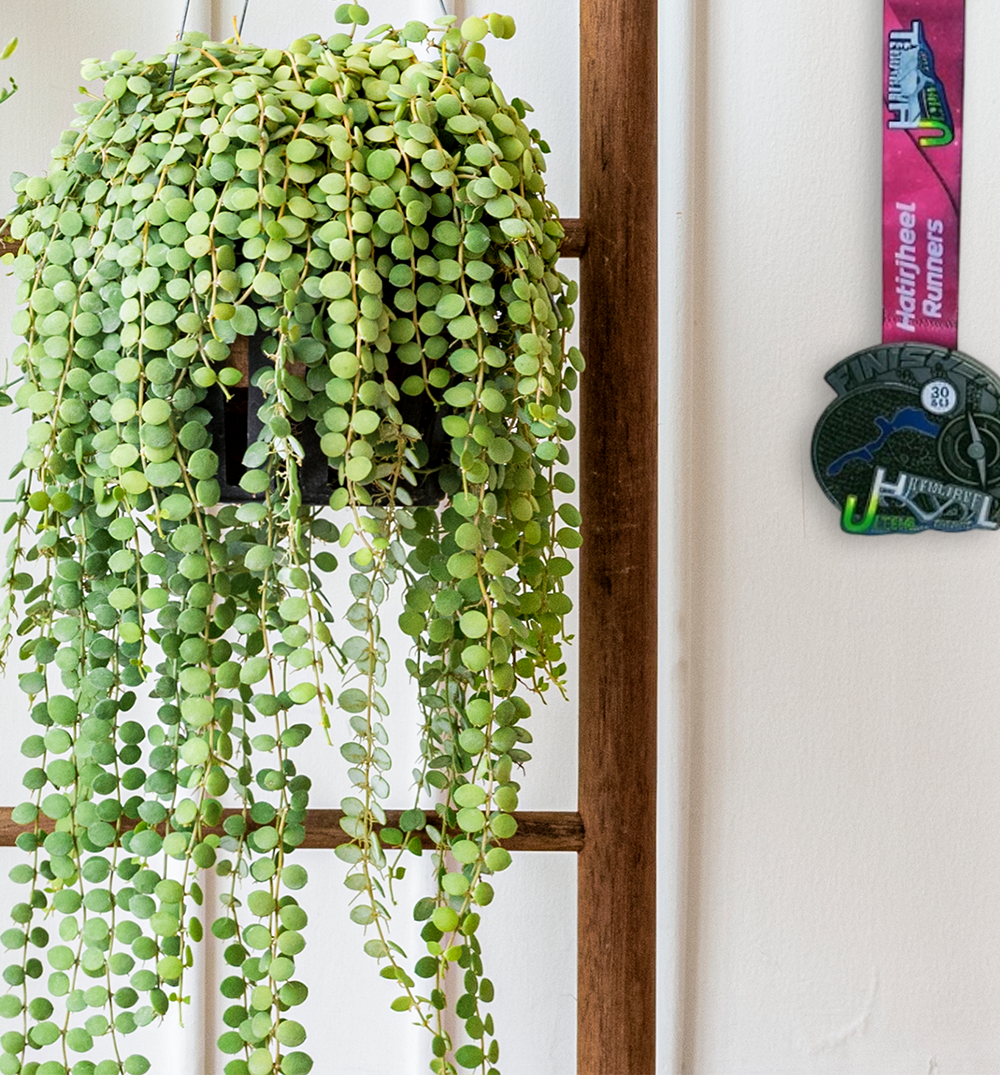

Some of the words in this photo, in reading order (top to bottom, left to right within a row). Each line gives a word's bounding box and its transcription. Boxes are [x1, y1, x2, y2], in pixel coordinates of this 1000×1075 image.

[895, 202, 921, 332] Hatirjheel
[922, 218, 944, 318] Runners
[931, 386, 949, 398] 30
